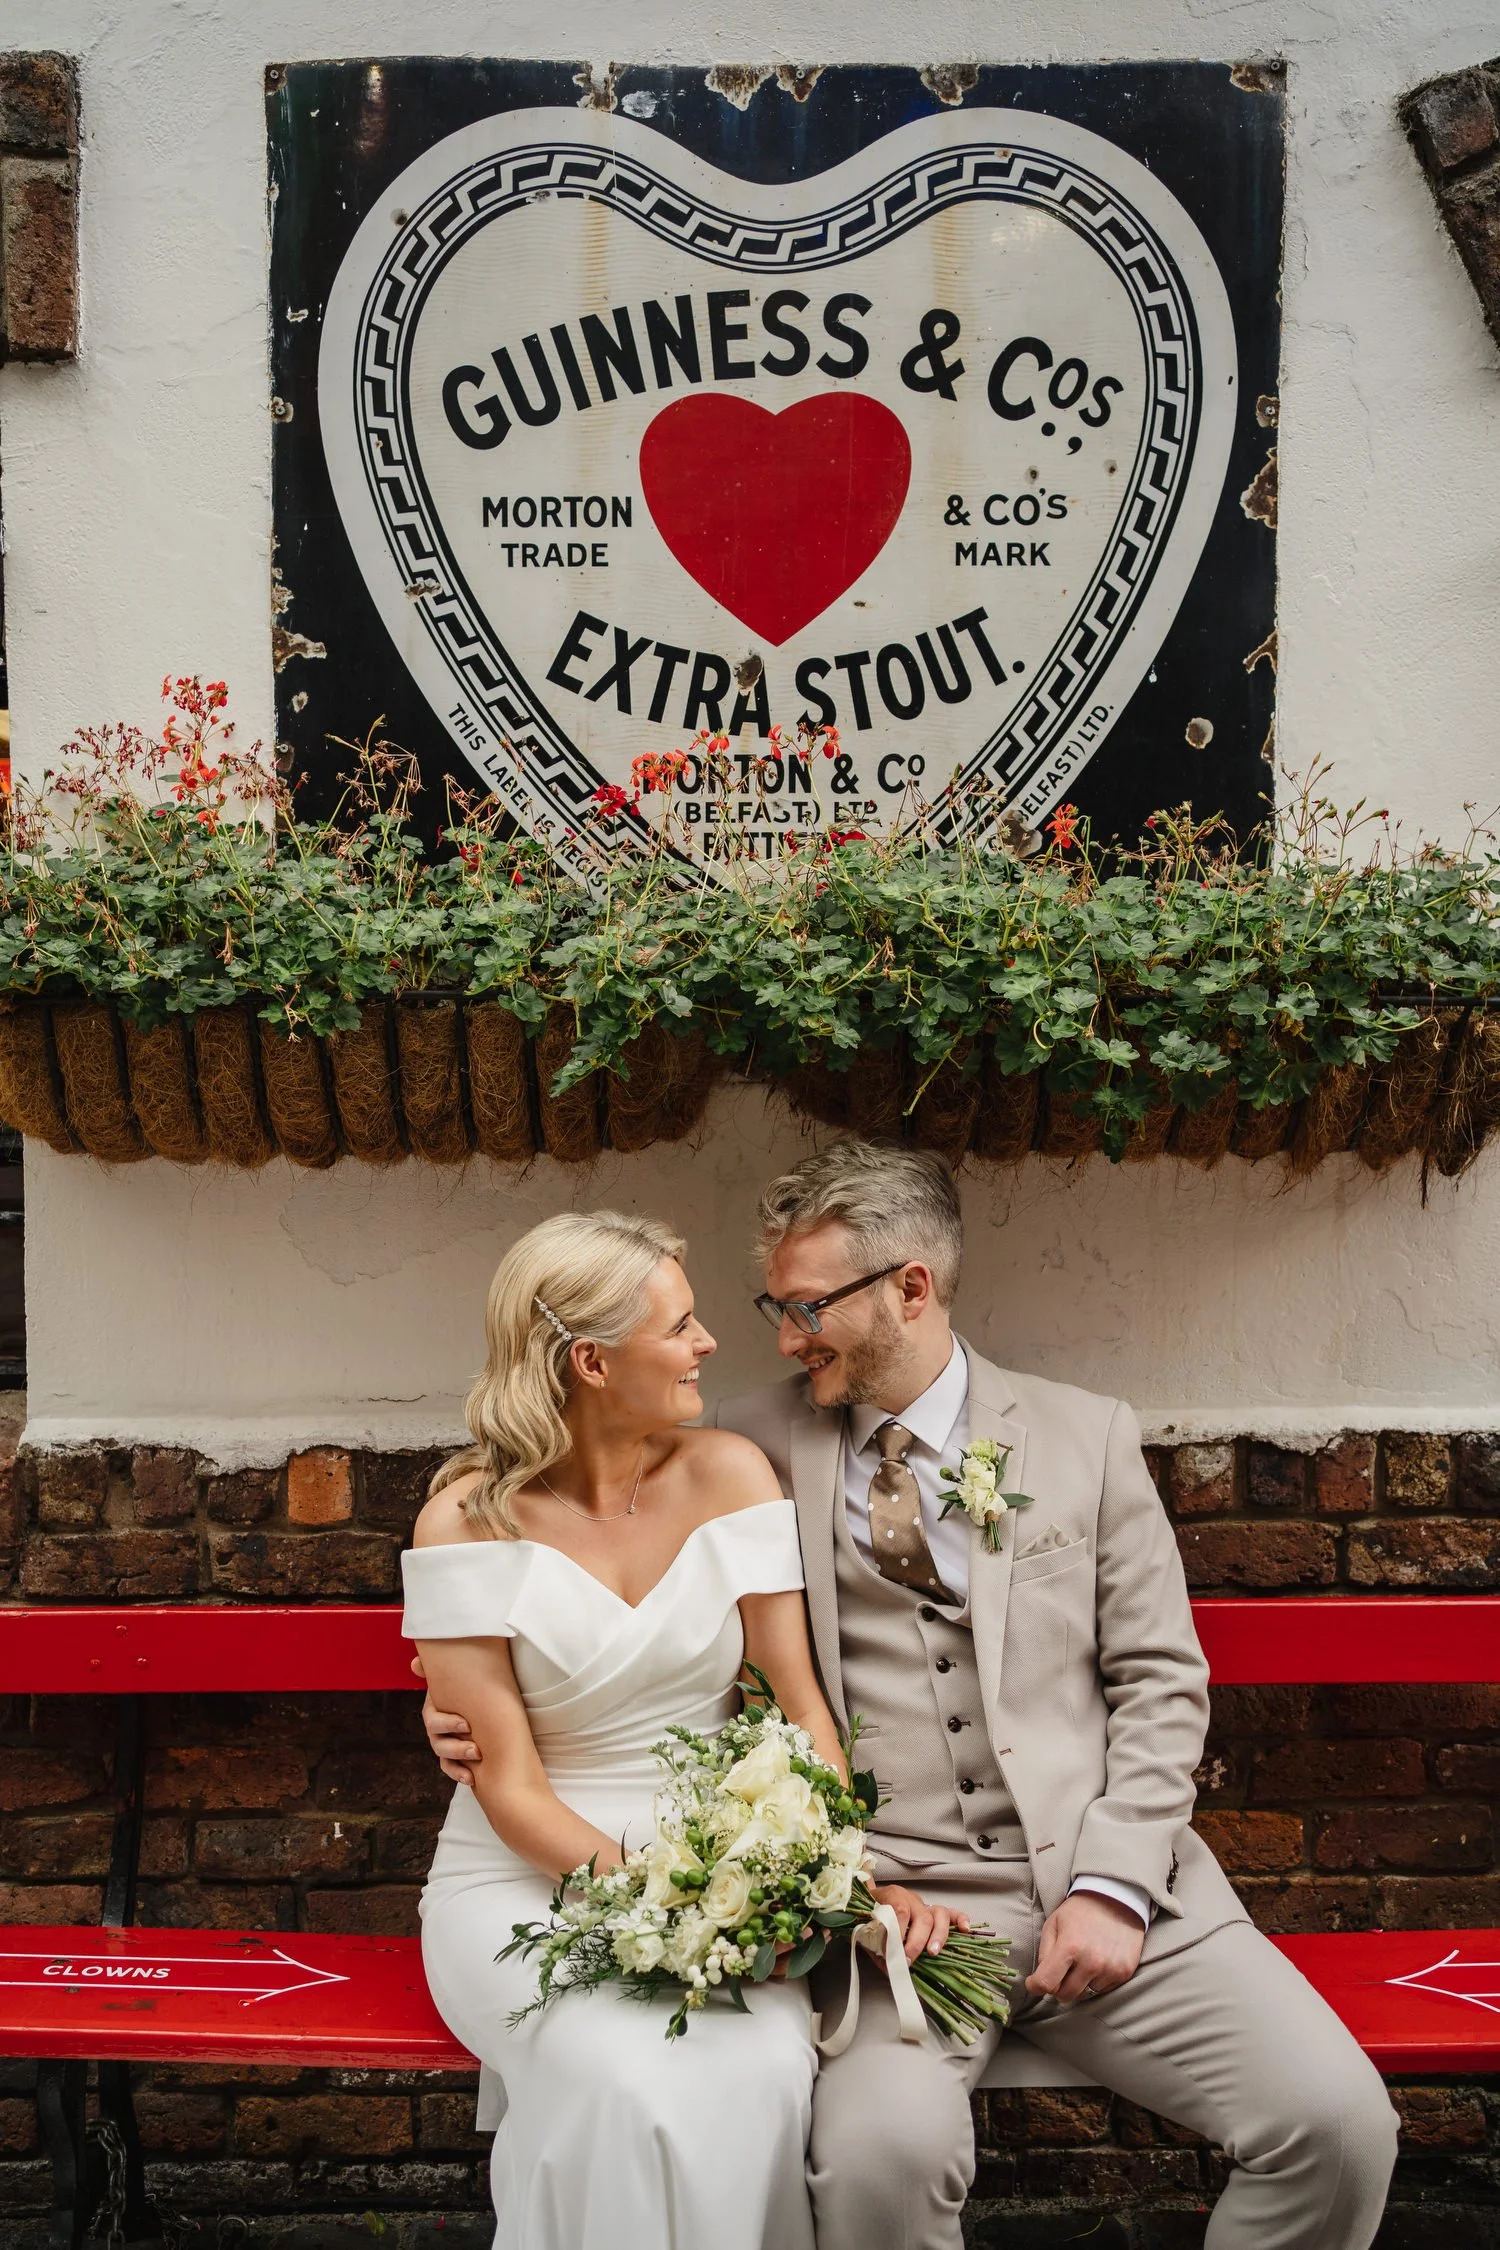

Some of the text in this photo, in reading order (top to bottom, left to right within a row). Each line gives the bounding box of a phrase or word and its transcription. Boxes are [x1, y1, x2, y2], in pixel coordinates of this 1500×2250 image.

[442, 289, 873, 450] GUINNESS
[900, 308, 966, 402] &
[482, 495, 632, 528] MORTON
[943, 494, 971, 526] &
[500, 542, 1051, 568] TRADE MARK
[545, 606, 1026, 738] EXTRA STOUT.
[448, 702, 487, 751] THIS
[1078, 703, 1115, 743] LTD.
[830, 753, 860, 795] &
[42, 1965, 171, 1979] CLOWNS
